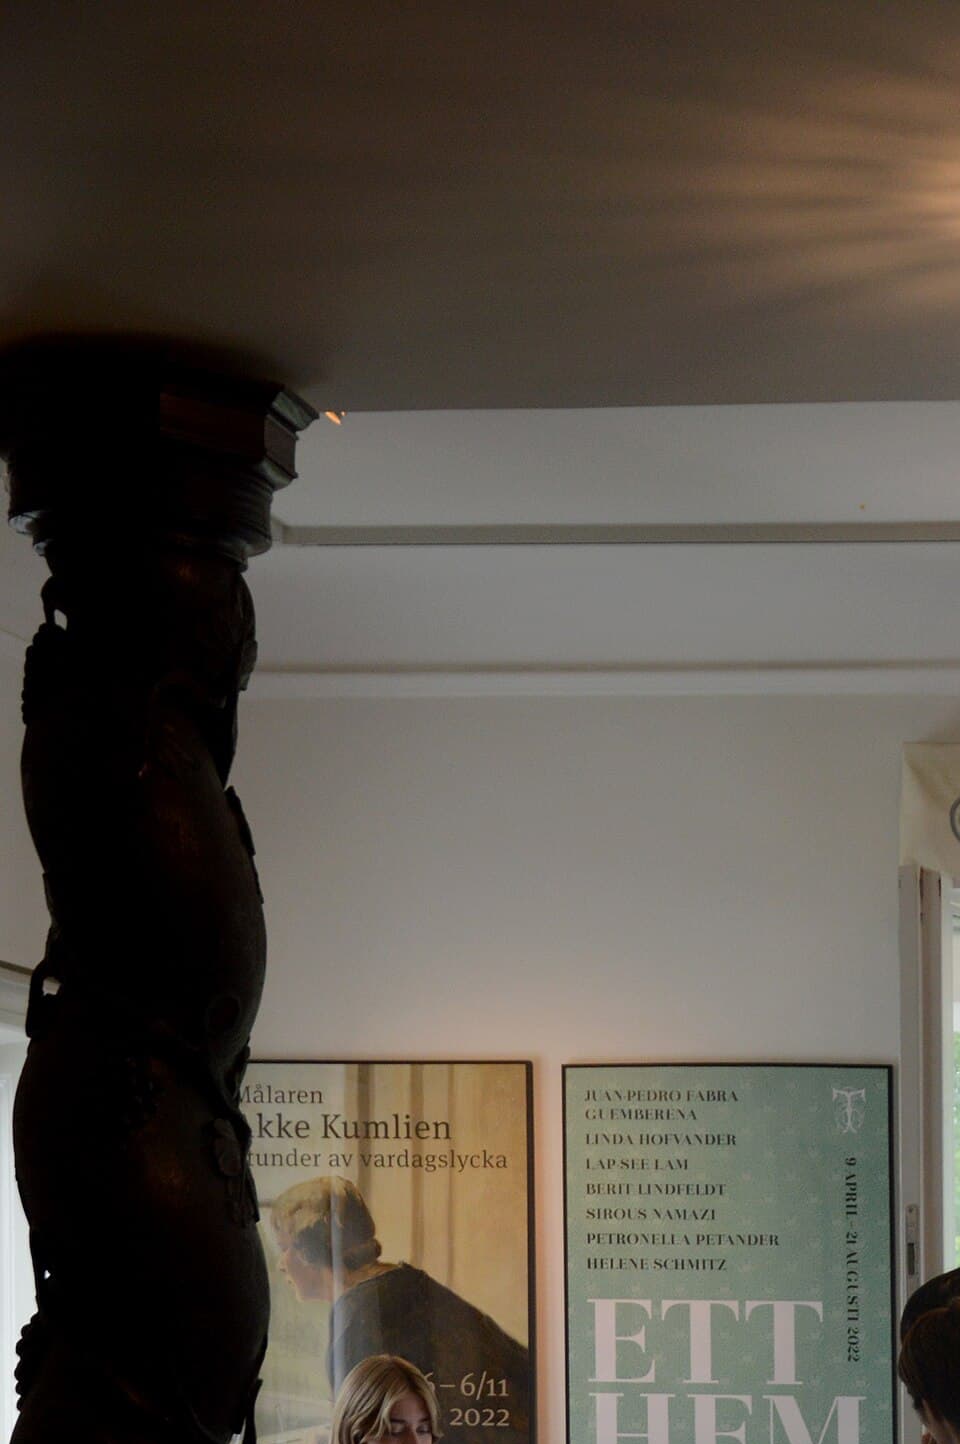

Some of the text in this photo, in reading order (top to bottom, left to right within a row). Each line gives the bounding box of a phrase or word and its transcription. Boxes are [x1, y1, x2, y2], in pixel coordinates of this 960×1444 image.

[585, 1090, 738, 1102] JUAN-PEDRO FABRA
[585, 1109, 697, 1121] GUEMBERENA
[250, 1112, 451, 1140] kke Kumlien
[585, 1133, 737, 1146] LINDA HOFVANDER
[247, 1147, 508, 1172] tunder av vardagslycka
[655, 1158, 689, 1170] LAM
[846, 1157, 857, 1166] 9
[586, 1183, 727, 1196] BERIT LINDFELDT
[845, 1170, 858, 1219] APRIL
[586, 1208, 716, 1221] SIROUS NAMAZI
[586, 1232, 779, 1246] PETRONELLA PETANDER
[846, 1231, 857, 1244] 21
[587, 1257, 727, 1271] HELENE SCHMITZ
[846, 1247, 858, 1321] AUGUSTI
[587, 1298, 824, 1385] ETT
[847, 1327, 859, 1362] 2022
[449, 1407, 510, 1427] 2022
